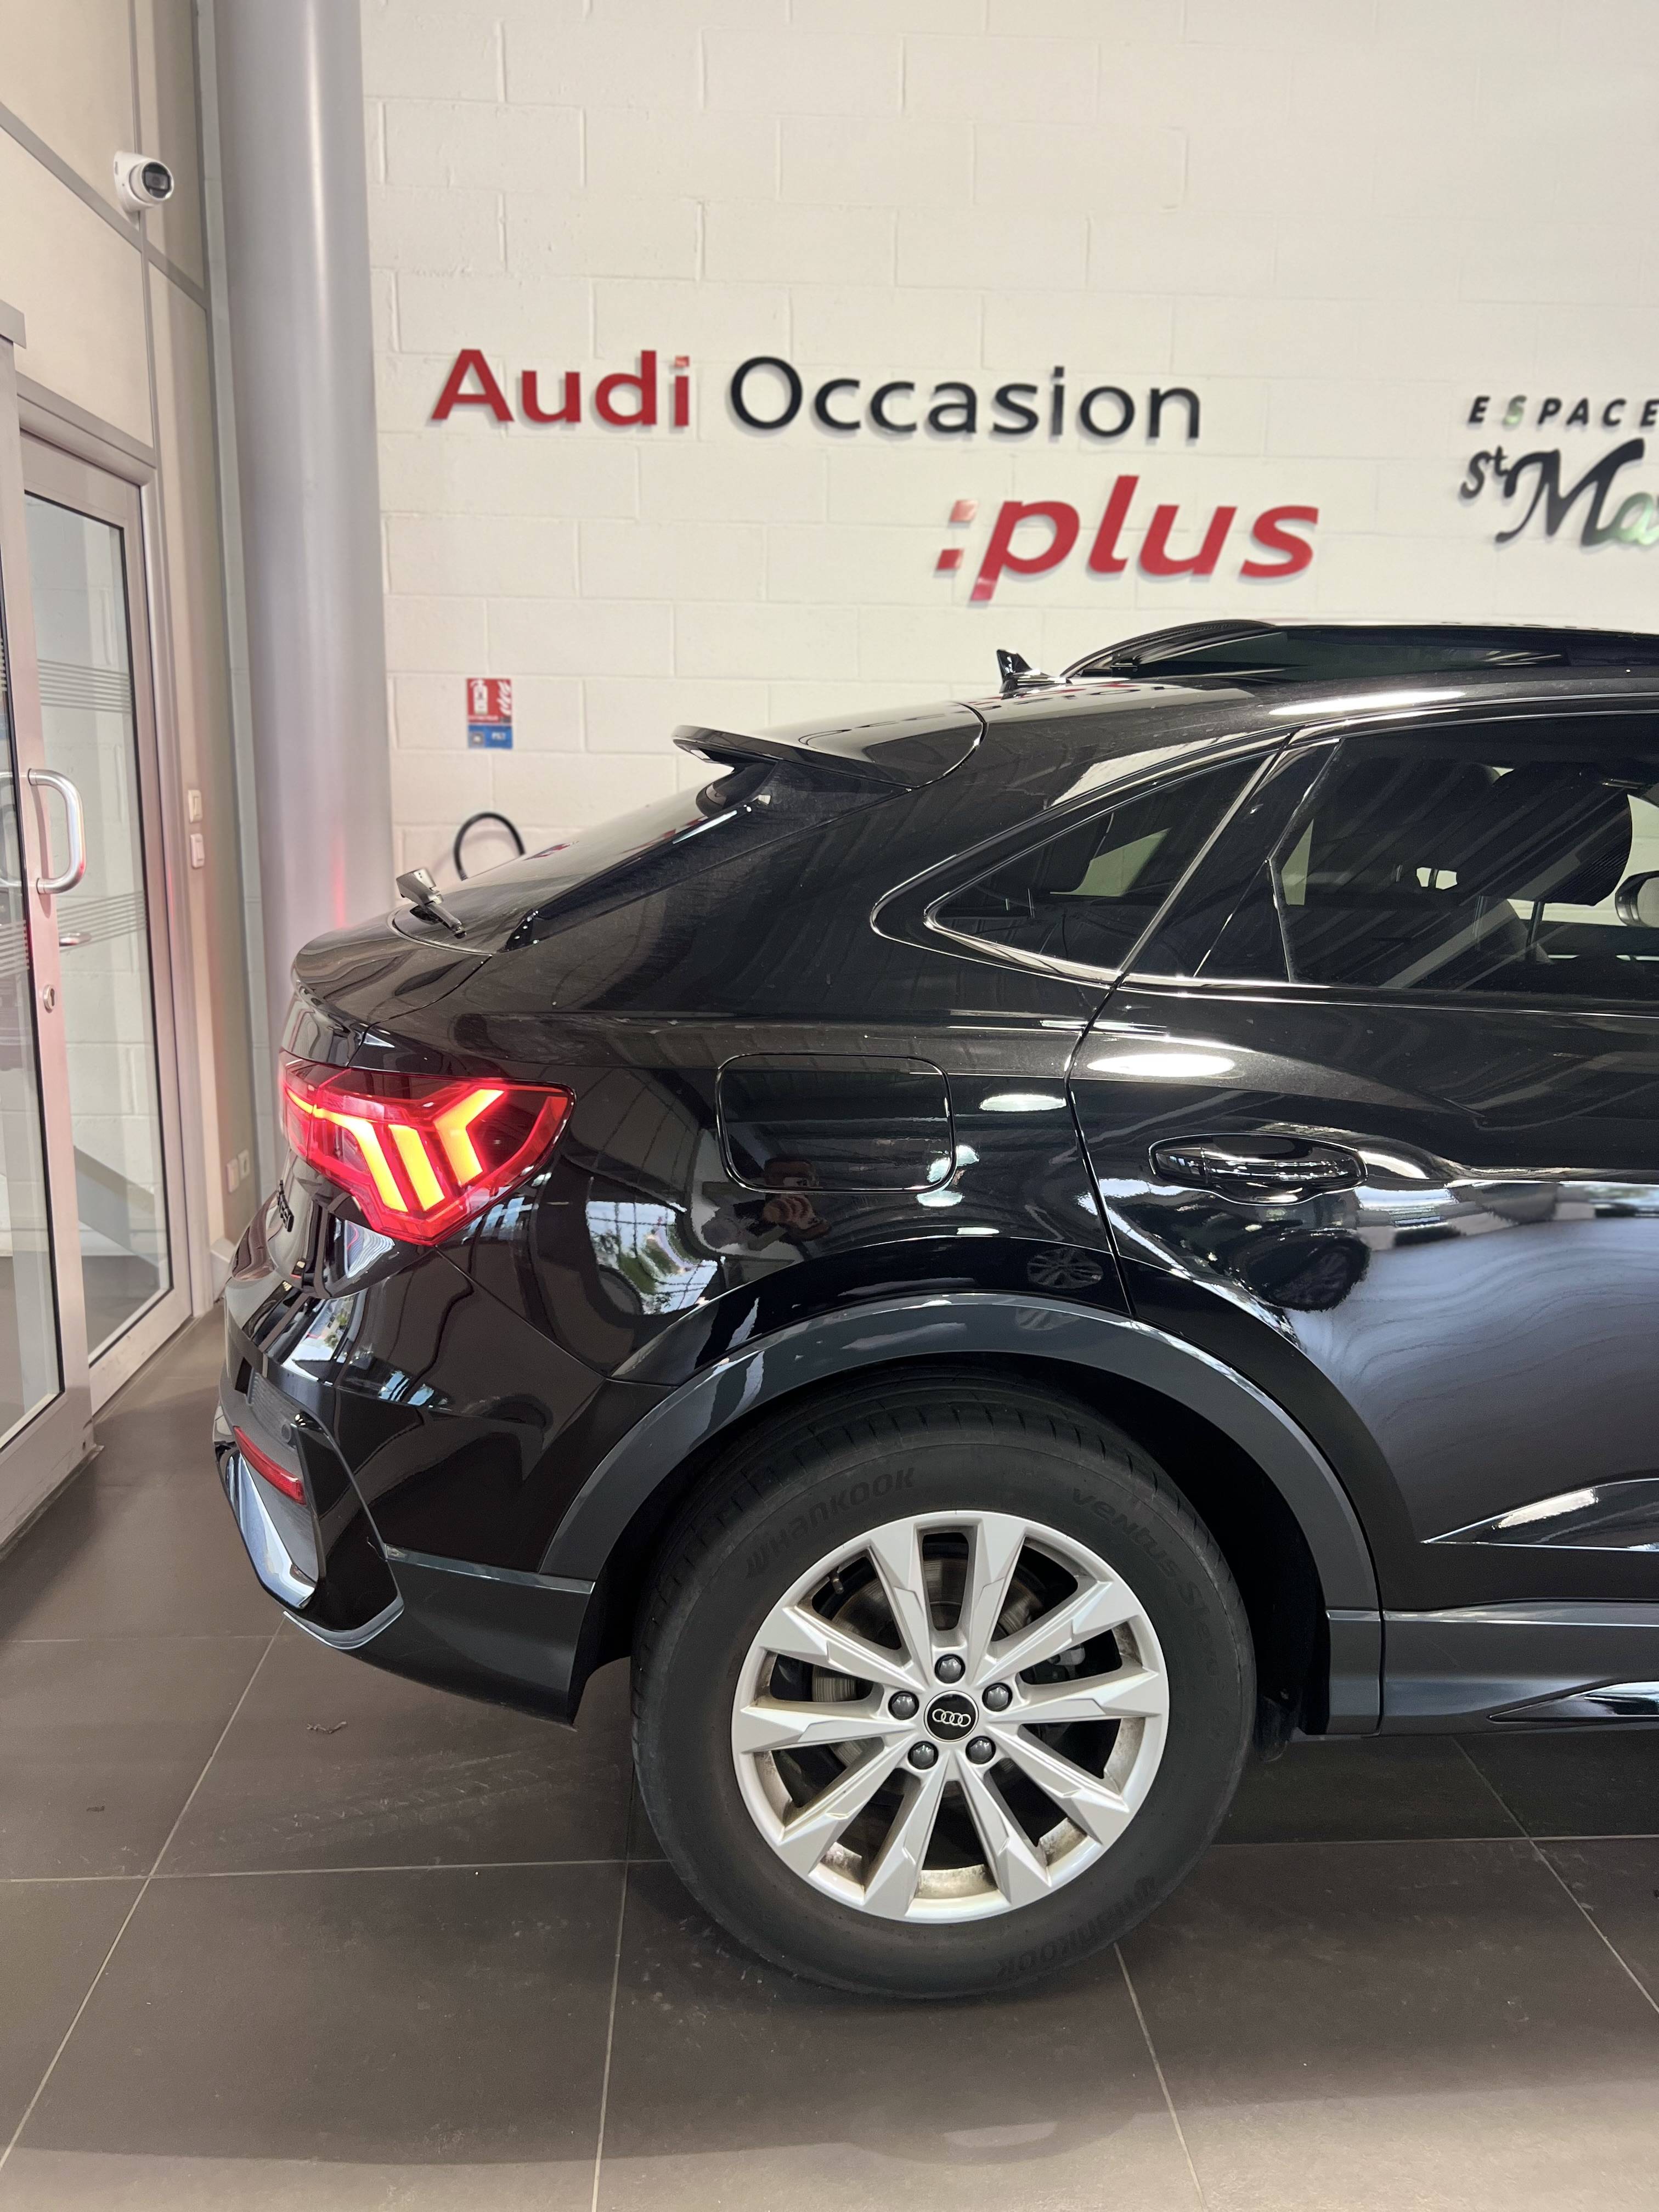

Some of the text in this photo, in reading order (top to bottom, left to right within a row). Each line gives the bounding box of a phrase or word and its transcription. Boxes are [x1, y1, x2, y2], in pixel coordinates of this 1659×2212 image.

[430, 348, 1201, 440] Audi Occasion
[1467, 394, 1659, 427] ESPACE
[1494, 437, 1659, 548] Ma
